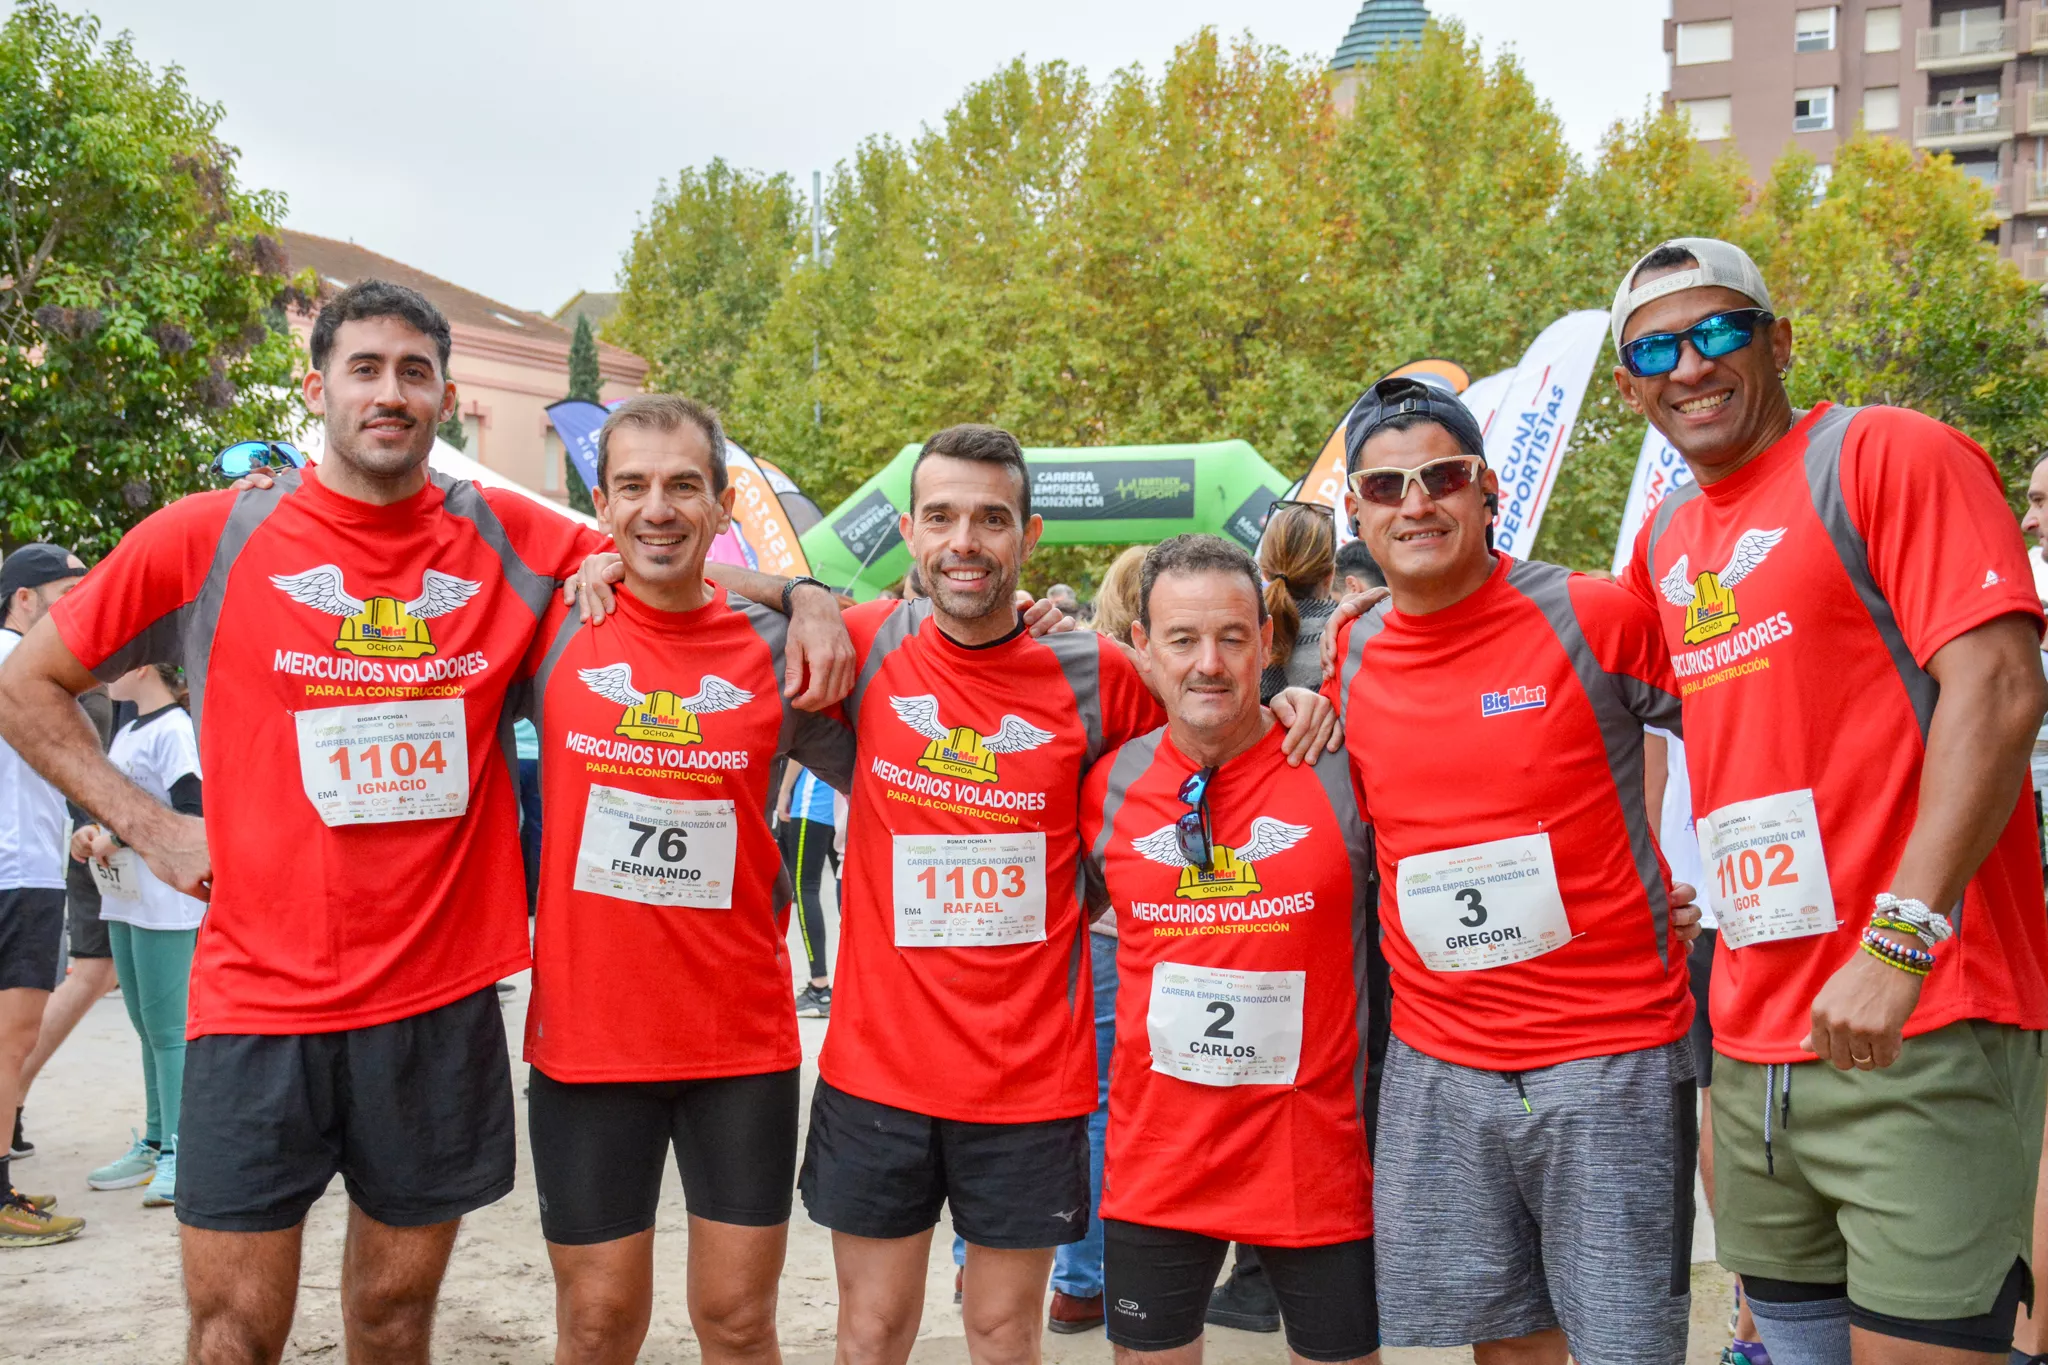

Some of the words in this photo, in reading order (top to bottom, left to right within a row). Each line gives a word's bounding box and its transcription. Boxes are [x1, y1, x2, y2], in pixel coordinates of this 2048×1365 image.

[1502, 412, 1539, 482] CUNA
[1037, 471, 1094, 483] CARRERA
[1497, 385, 1564, 551] DEPORTISTAS
[1033, 483, 1100, 495] EMPRESAS
[1031, 494, 1083, 507] MONZÓN
[1085, 496, 1104, 507] CM
[1697, 601, 1723, 620] BigMat
[362, 623, 407, 638] BigMat
[1700, 621, 1722, 634] OCHOA
[367, 643, 404, 652] OCHOA
[1714, 611, 1793, 666] VOLADORES
[274, 649, 384, 682] MERCURIOS
[387, 651, 488, 683] VOLADORES
[1707, 657, 1770, 687] CONSTRUCCIÓN
[306, 685, 343, 696] PARA
[348, 686, 364, 696] LA
[365, 684, 464, 697] CONSTRUCCIÓN
[1481, 686, 1546, 717] BigMat
[640, 713, 679, 727] BigMat
[315, 738, 356, 748] CARRERA
[358, 735, 405, 744] EMPRESAS
[406, 730, 441, 740] MONZÓN
[442, 731, 455, 739] CM
[643, 729, 675, 738] OCHOA
[566, 731, 654, 765] MERCURIOS
[657, 748, 748, 769] VOLADORES
[942, 748, 979, 765] BigMat
[329, 740, 447, 780] 1104
[943, 763, 973, 775] OCHOA
[586, 762, 617, 773] PARA
[620, 766, 634, 775] LA
[636, 767, 723, 784] CONSTRUCCIÓN
[357, 779, 427, 794] IGNACIO
[872, 756, 951, 799] MERCURIOS
[955, 783, 1046, 811] VOLADORES
[318, 790, 338, 799] EM4
[887, 789, 916, 804] PARA
[918, 795, 931, 808] LA
[934, 800, 1019, 825] CONSTRUCCIÓN
[599, 806, 634, 820] CARRERA
[635, 815, 679, 827] EMPRESAS
[681, 819, 714, 828] MONZÓN
[629, 821, 688, 863] 76
[1750, 832, 1788, 846] MONZÓN
[1791, 830, 1806, 840] CM
[611, 859, 701, 880] FERNANDO
[907, 858, 944, 866] CARRERA
[946, 858, 987, 866] EMPRESAS
[989, 856, 1023, 864] MONZÓN
[1198, 869, 1236, 882] BigMat
[1717, 843, 1798, 898] 1102
[917, 865, 1026, 899] 1103
[1202, 885, 1234, 893] OCHOA
[1407, 885, 1441, 897] CARRERA
[1443, 878, 1485, 891] EMPRESAS
[1487, 869, 1525, 883] MONZÓN
[1526, 868, 1540, 877] CM
[905, 907, 921, 915] EM4
[944, 902, 1003, 913] RAFAEL
[1131, 901, 1215, 923] MERCURIOS
[1220, 892, 1315, 922] VOLADORES
[1455, 888, 1488, 928] 3
[1734, 893, 1761, 912] IGOR
[1153, 928, 1184, 937] PARA
[1186, 927, 1199, 935] LA
[1200, 921, 1289, 935] CONSTRUCCIÓN
[1446, 926, 1522, 949] GREGORI
[1162, 987, 1195, 997] CARRERA
[1197, 992, 1241, 1002] EMPRESAS
[1243, 994, 1277, 1003] MONZÓN
[1204, 1001, 1235, 1039] 2
[1190, 1042, 1255, 1057] CARLOS
